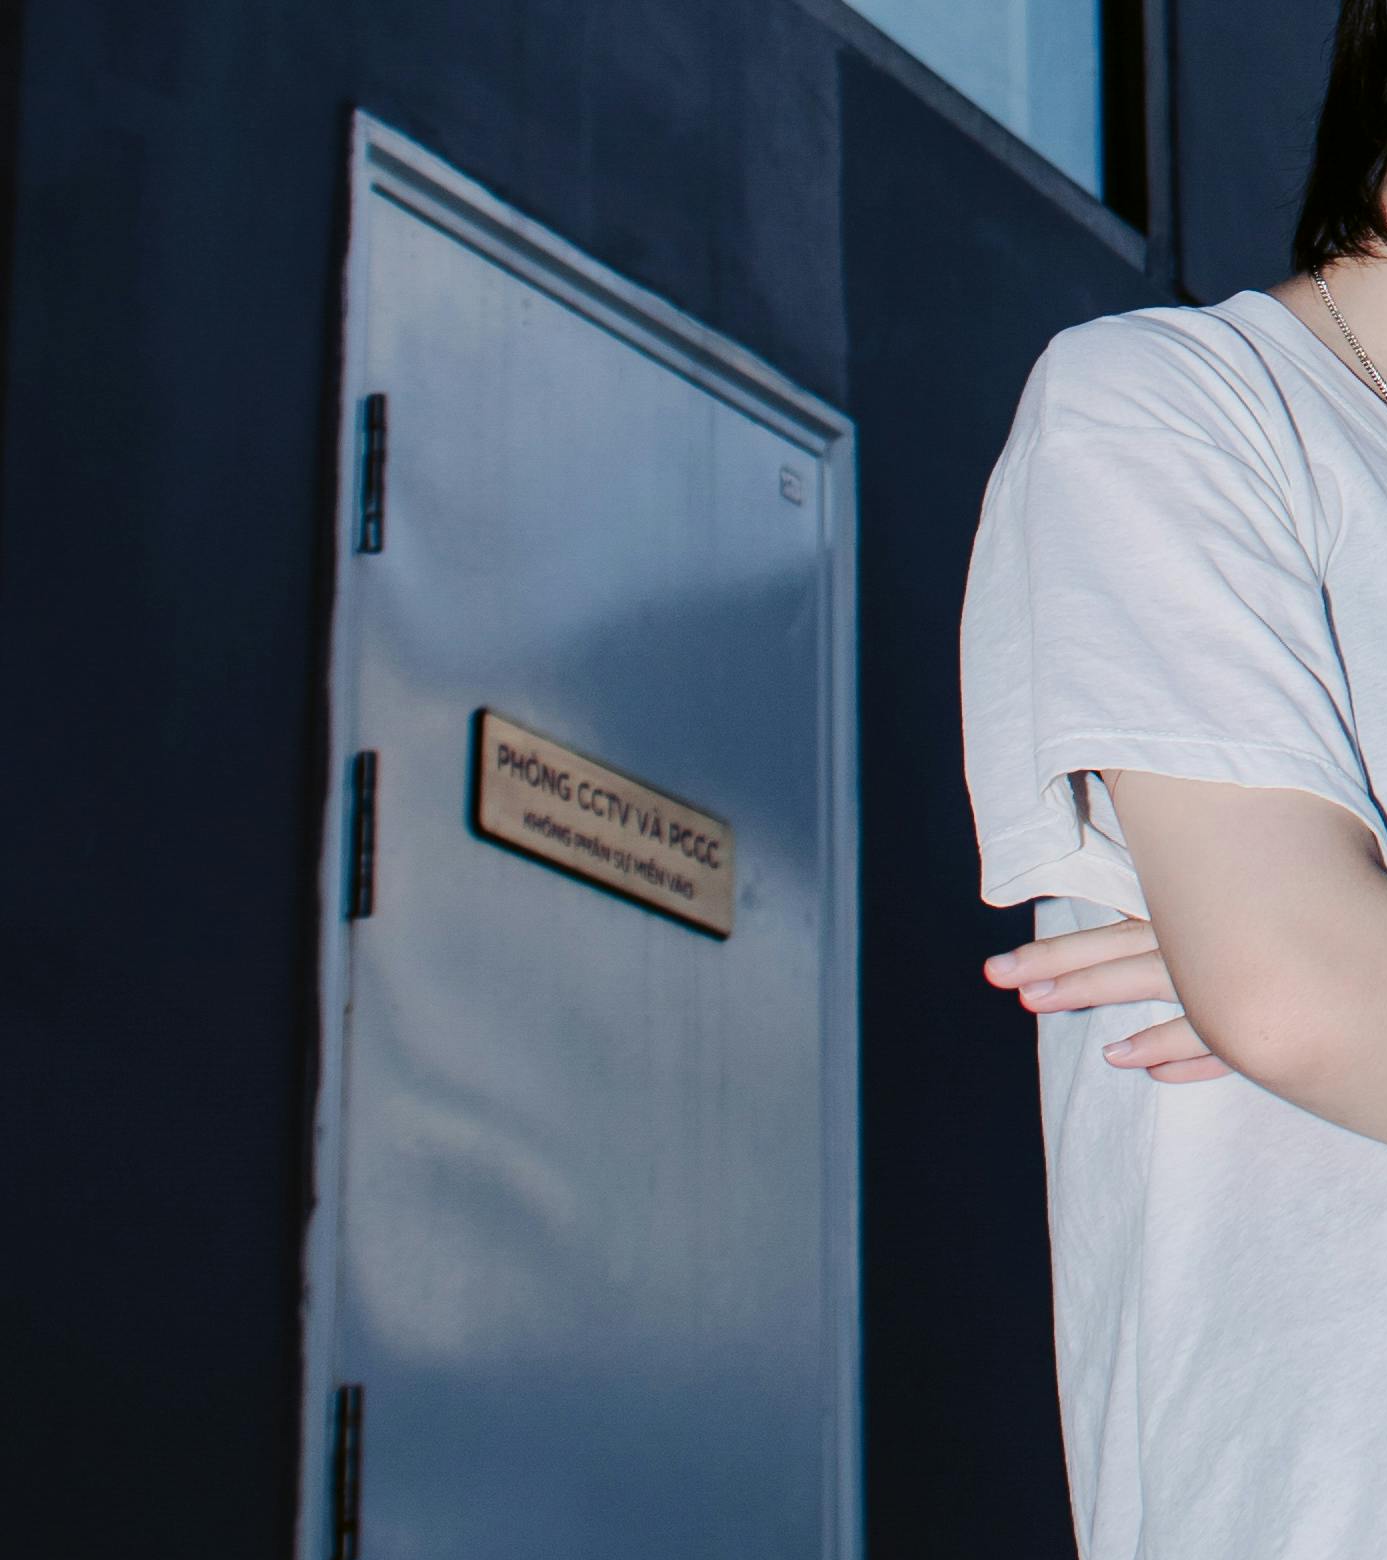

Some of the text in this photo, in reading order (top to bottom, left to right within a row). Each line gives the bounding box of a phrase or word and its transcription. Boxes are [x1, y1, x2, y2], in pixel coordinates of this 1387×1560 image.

[497, 743, 720, 870] PHÒNG CCTV VÀ PCCC
